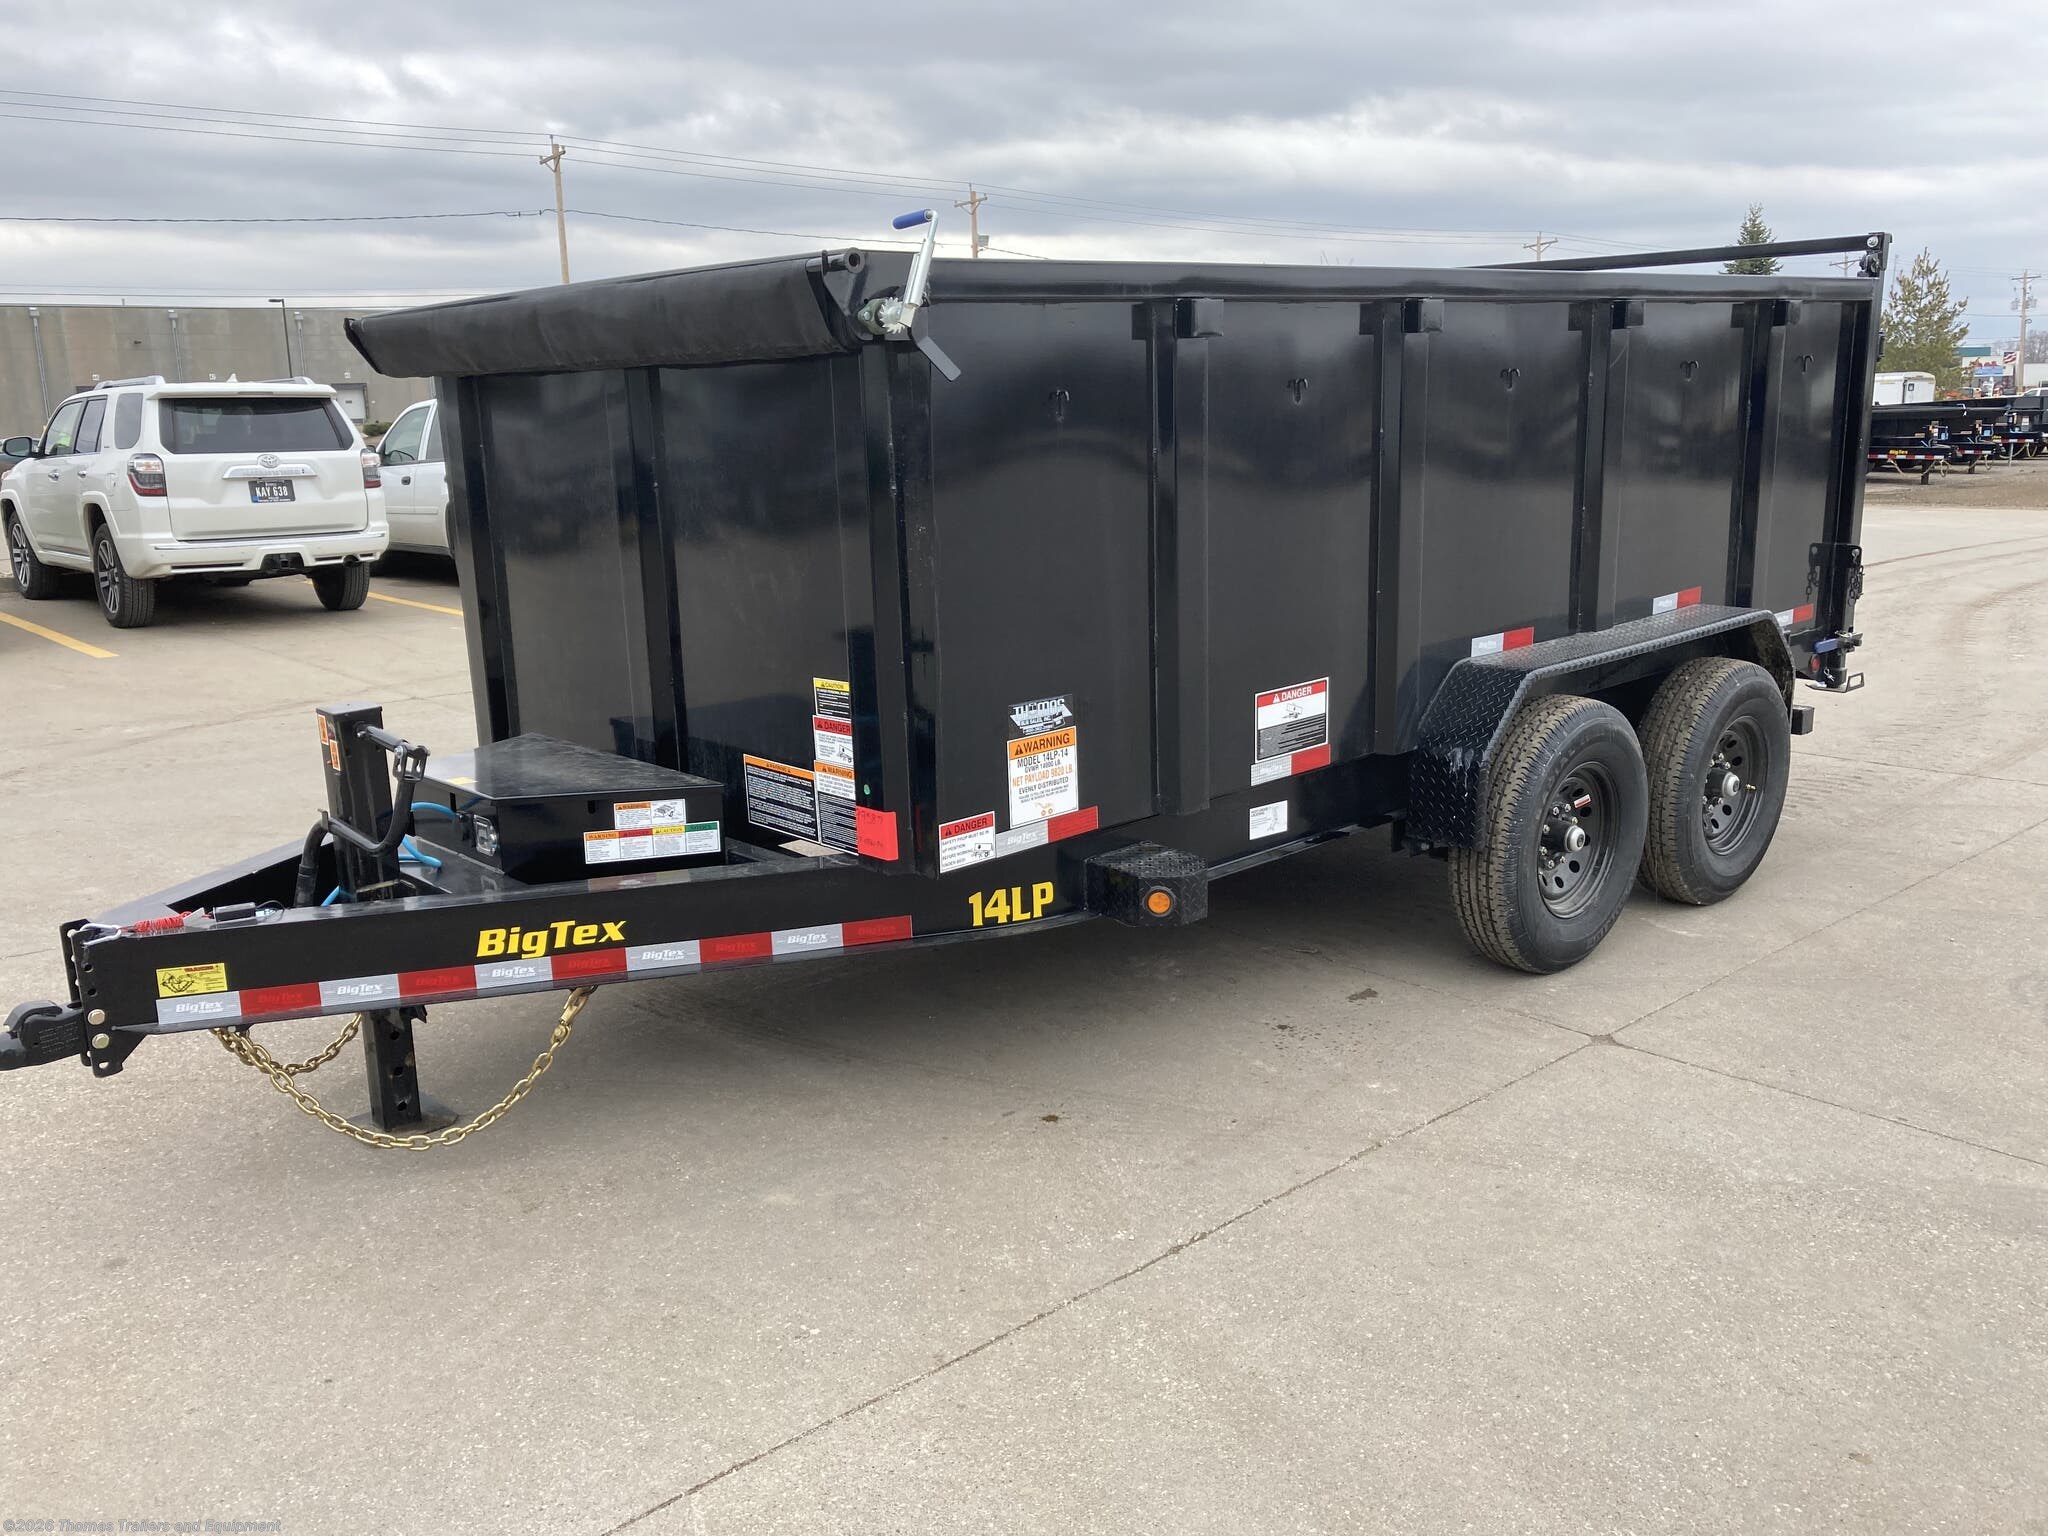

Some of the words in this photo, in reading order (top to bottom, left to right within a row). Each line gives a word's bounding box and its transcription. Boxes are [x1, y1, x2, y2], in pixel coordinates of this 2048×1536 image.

[255, 486, 271, 497] KAY
[272, 485, 288, 496] 638
[1281, 685, 1313, 701] DANGER
[824, 720, 851, 734] DANGER
[1023, 732, 1070, 753] WARNING
[1017, 754, 1040, 769] MODEL
[1042, 748, 1069, 761] 14LP-14
[827, 764, 852, 779] WARNING
[1012, 775, 1023, 787] NET
[1024, 769, 1049, 784] PAYLOAD
[1018, 784, 1037, 795] EVENLY
[1037, 776, 1069, 790] DISTRIBUTED
[954, 817, 988, 834] DANGER
[968, 881, 1054, 927] 14LP
[476, 920, 627, 960] BigTex
[787, 932, 828, 944] BigTex
[641, 949, 685, 961] BigTex
[491, 965, 537, 978] BigTex
[336, 983, 383, 996] BigTex
[175, 1000, 224, 1013] BigTex
